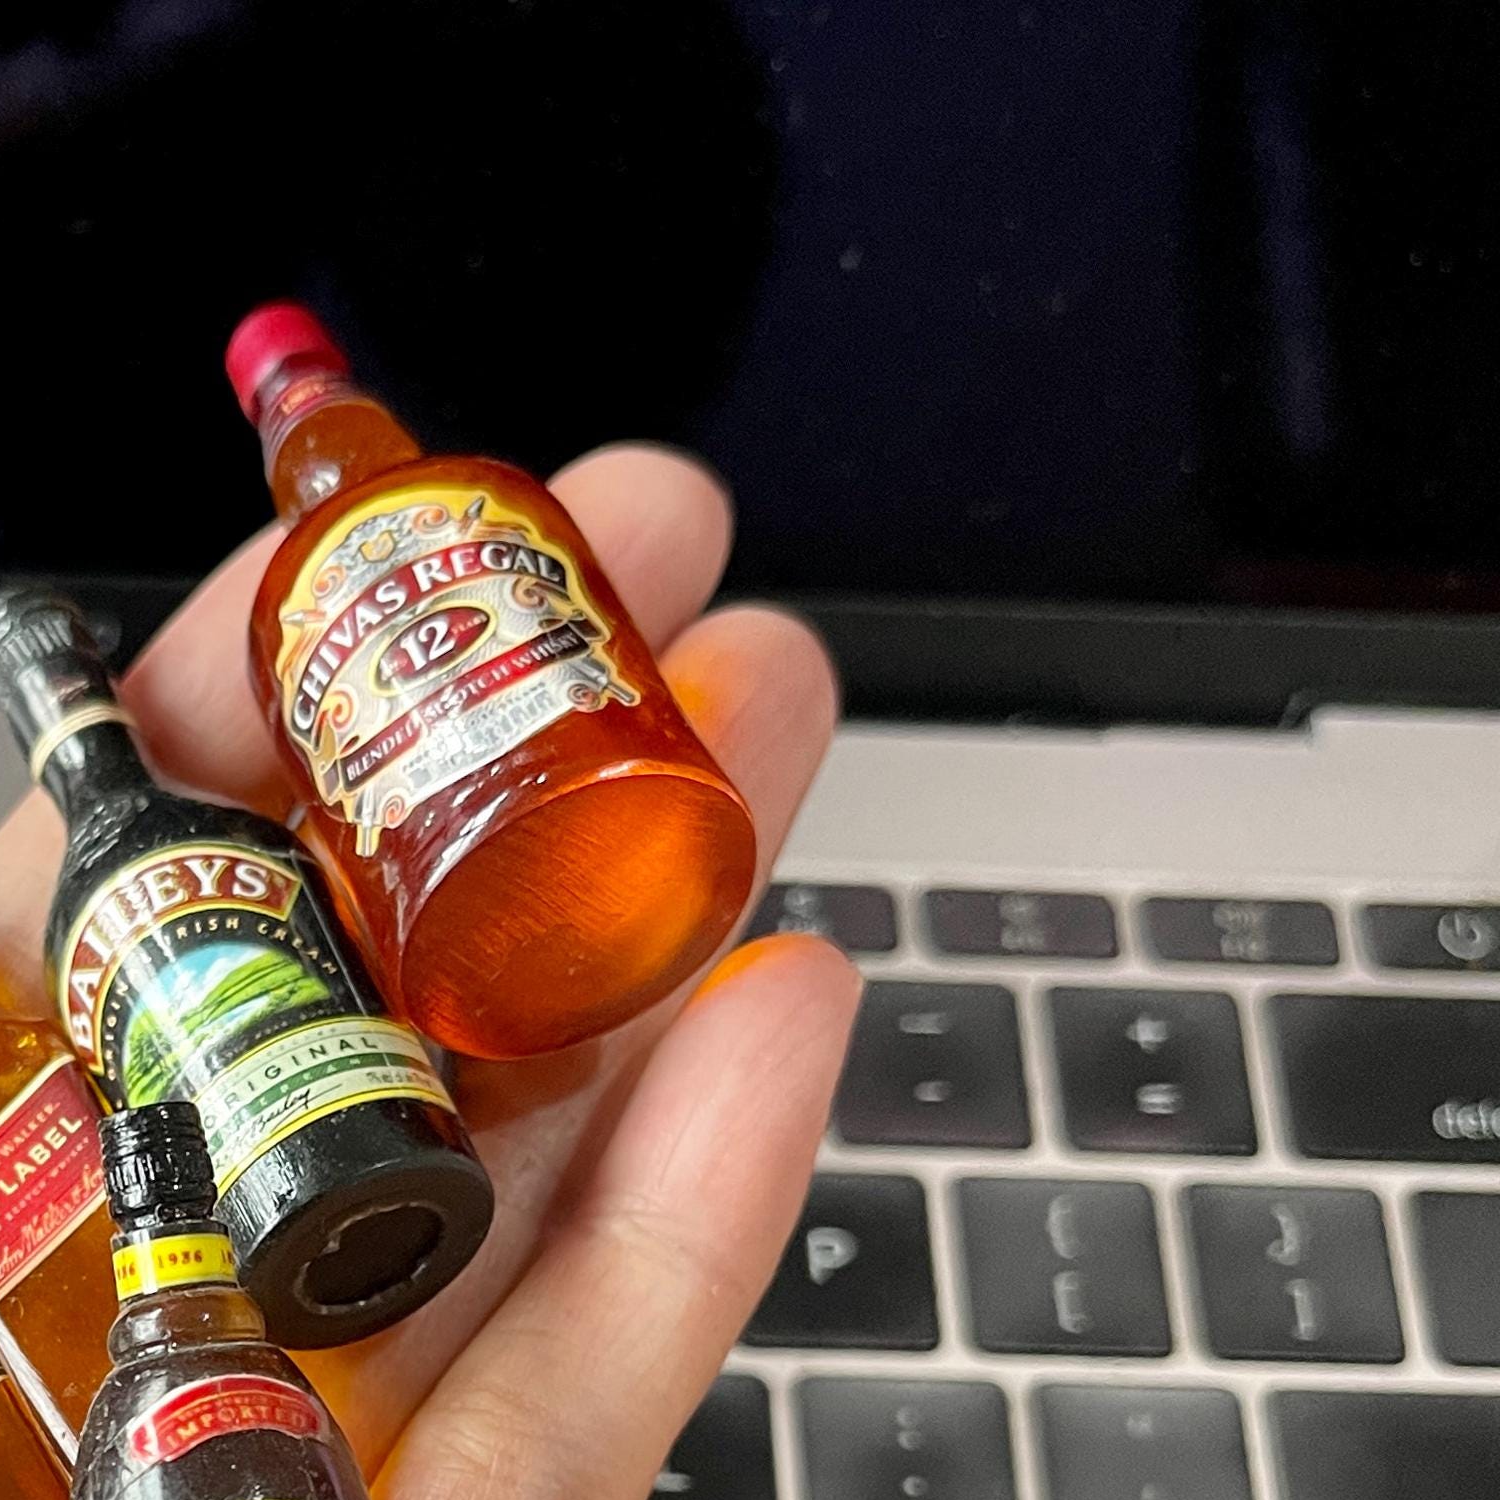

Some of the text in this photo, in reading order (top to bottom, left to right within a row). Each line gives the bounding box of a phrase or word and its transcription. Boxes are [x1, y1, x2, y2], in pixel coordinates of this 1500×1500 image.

[293, 542, 561, 731] CHIVAS REGAL
[400, 615, 456, 672] 12
[511, 631, 582, 670] WHISKY
[70, 857, 271, 1052] BAILEYS
[257, 920, 338, 975] CREAM
[202, 1036, 380, 1131] ORIGINAL
[157, 1249, 204, 1268] 1936
[806, 1226, 857, 1285] P
[165, 1404, 309, 1450] IMPORTED
